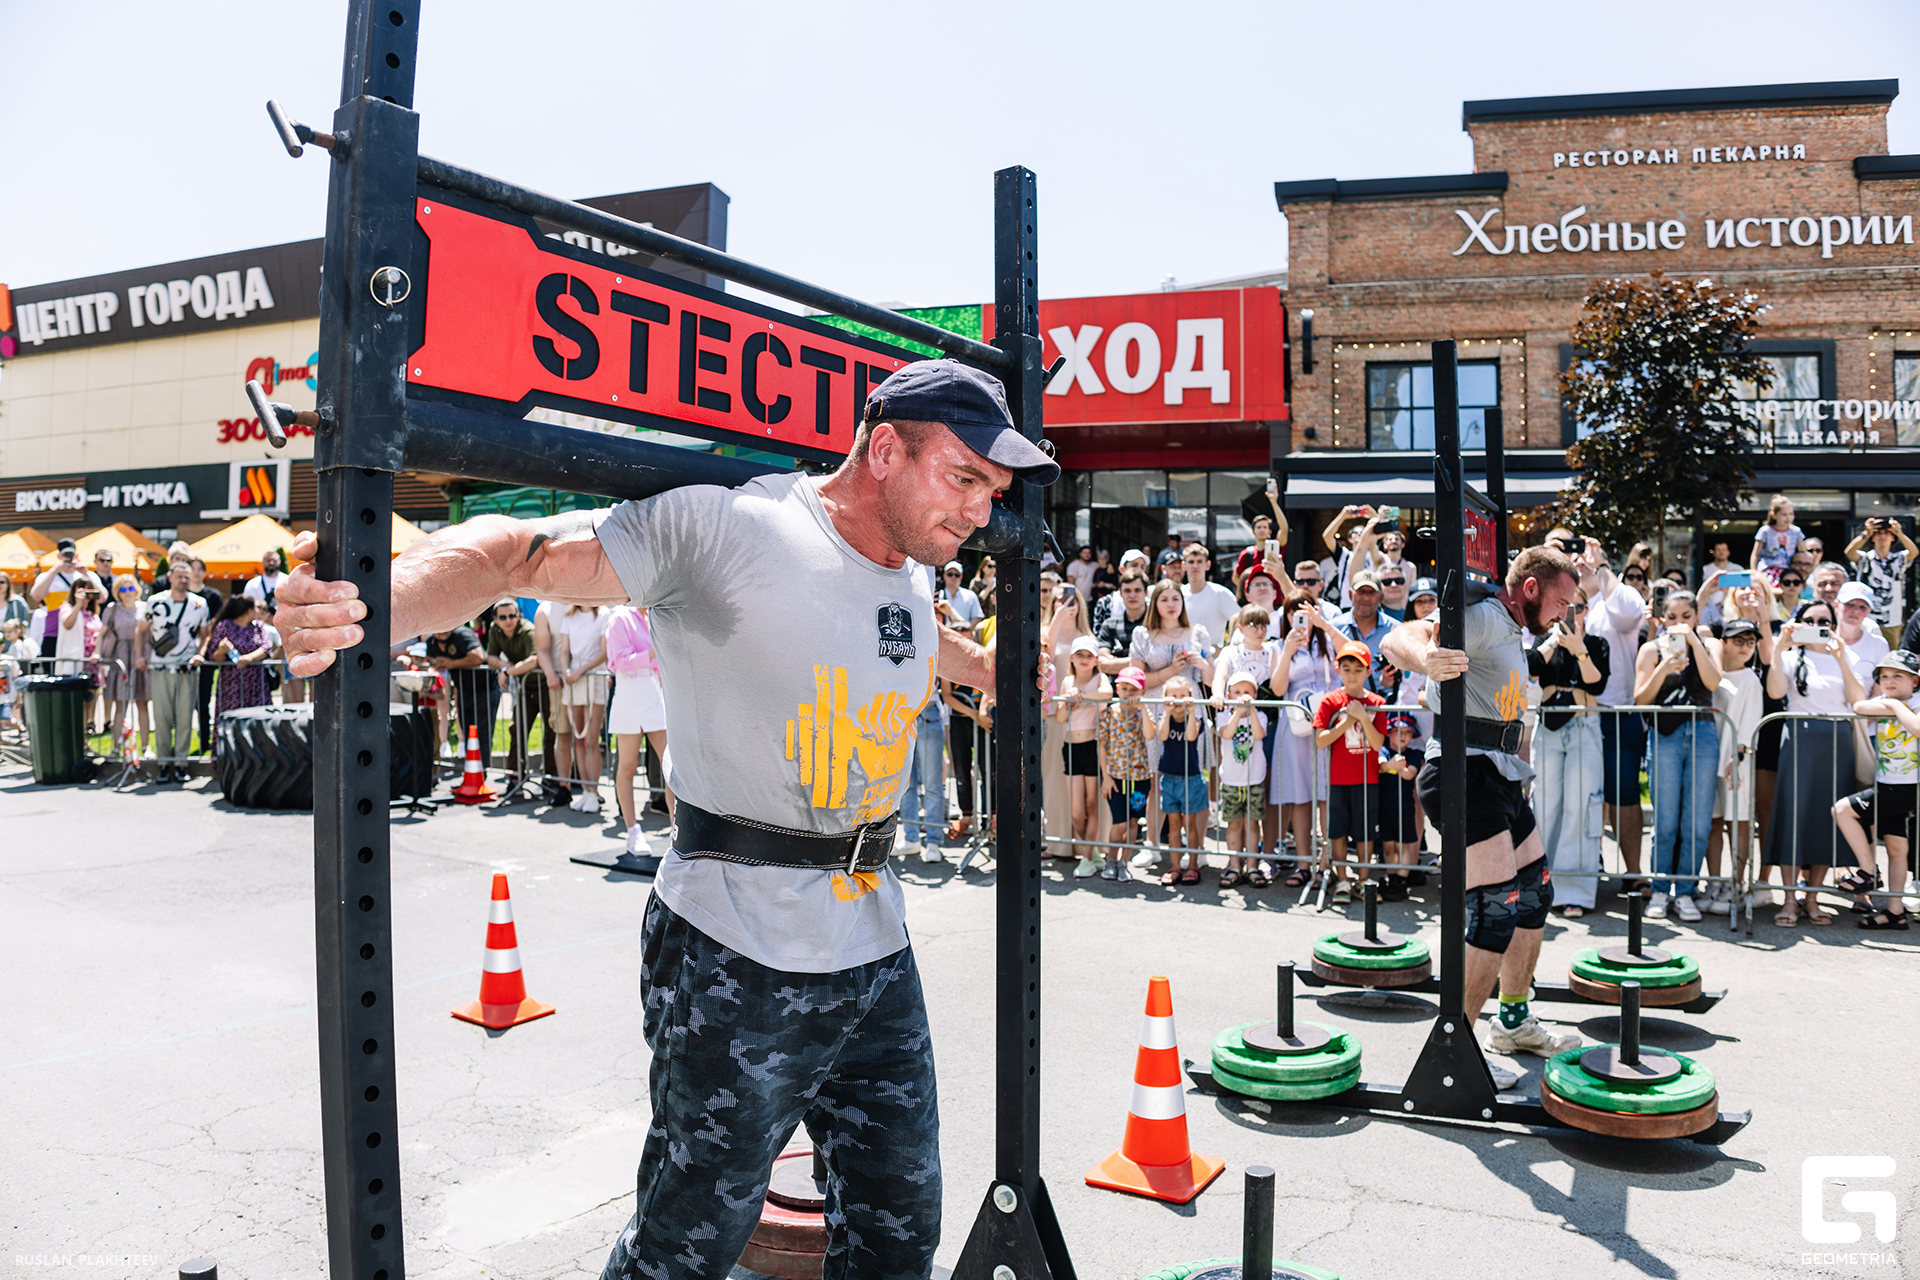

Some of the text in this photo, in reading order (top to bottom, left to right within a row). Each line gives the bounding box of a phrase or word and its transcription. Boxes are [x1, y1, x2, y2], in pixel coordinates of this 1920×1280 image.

[1553, 144, 1806, 168] РЕСТОРАН ПЕКАРНЯ
[1452, 205, 1914, 259] Хлебные истории
[15, 266, 275, 346] ЦЕНТР ГОРОДА
[1039, 317, 1231, 406] ХОД
[1787, 430, 1881, 445] ПЕКАРНЯ
[121, 481, 190, 507] ТОЧКА
[879, 639, 915, 658] КУБАНЬ
